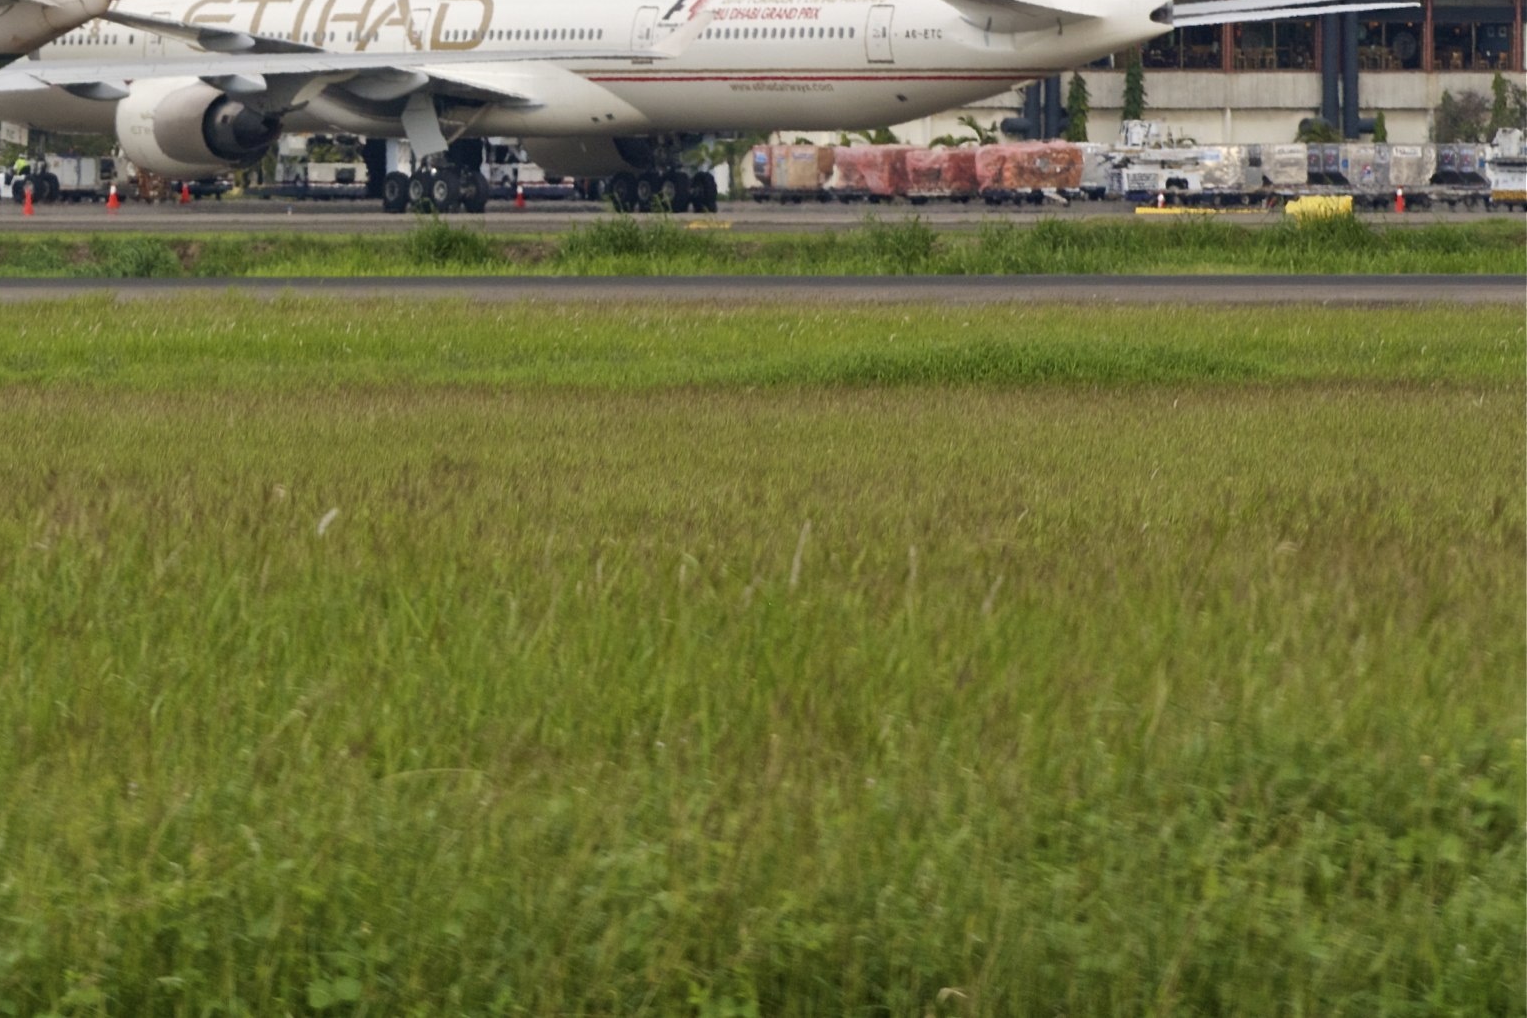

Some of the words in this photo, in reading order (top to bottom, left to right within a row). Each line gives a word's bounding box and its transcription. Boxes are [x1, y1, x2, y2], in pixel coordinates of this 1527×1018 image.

[728, 7, 760, 20] DHABI
[760, 7, 798, 20] GRAND
[798, 6, 821, 20] PRIX
